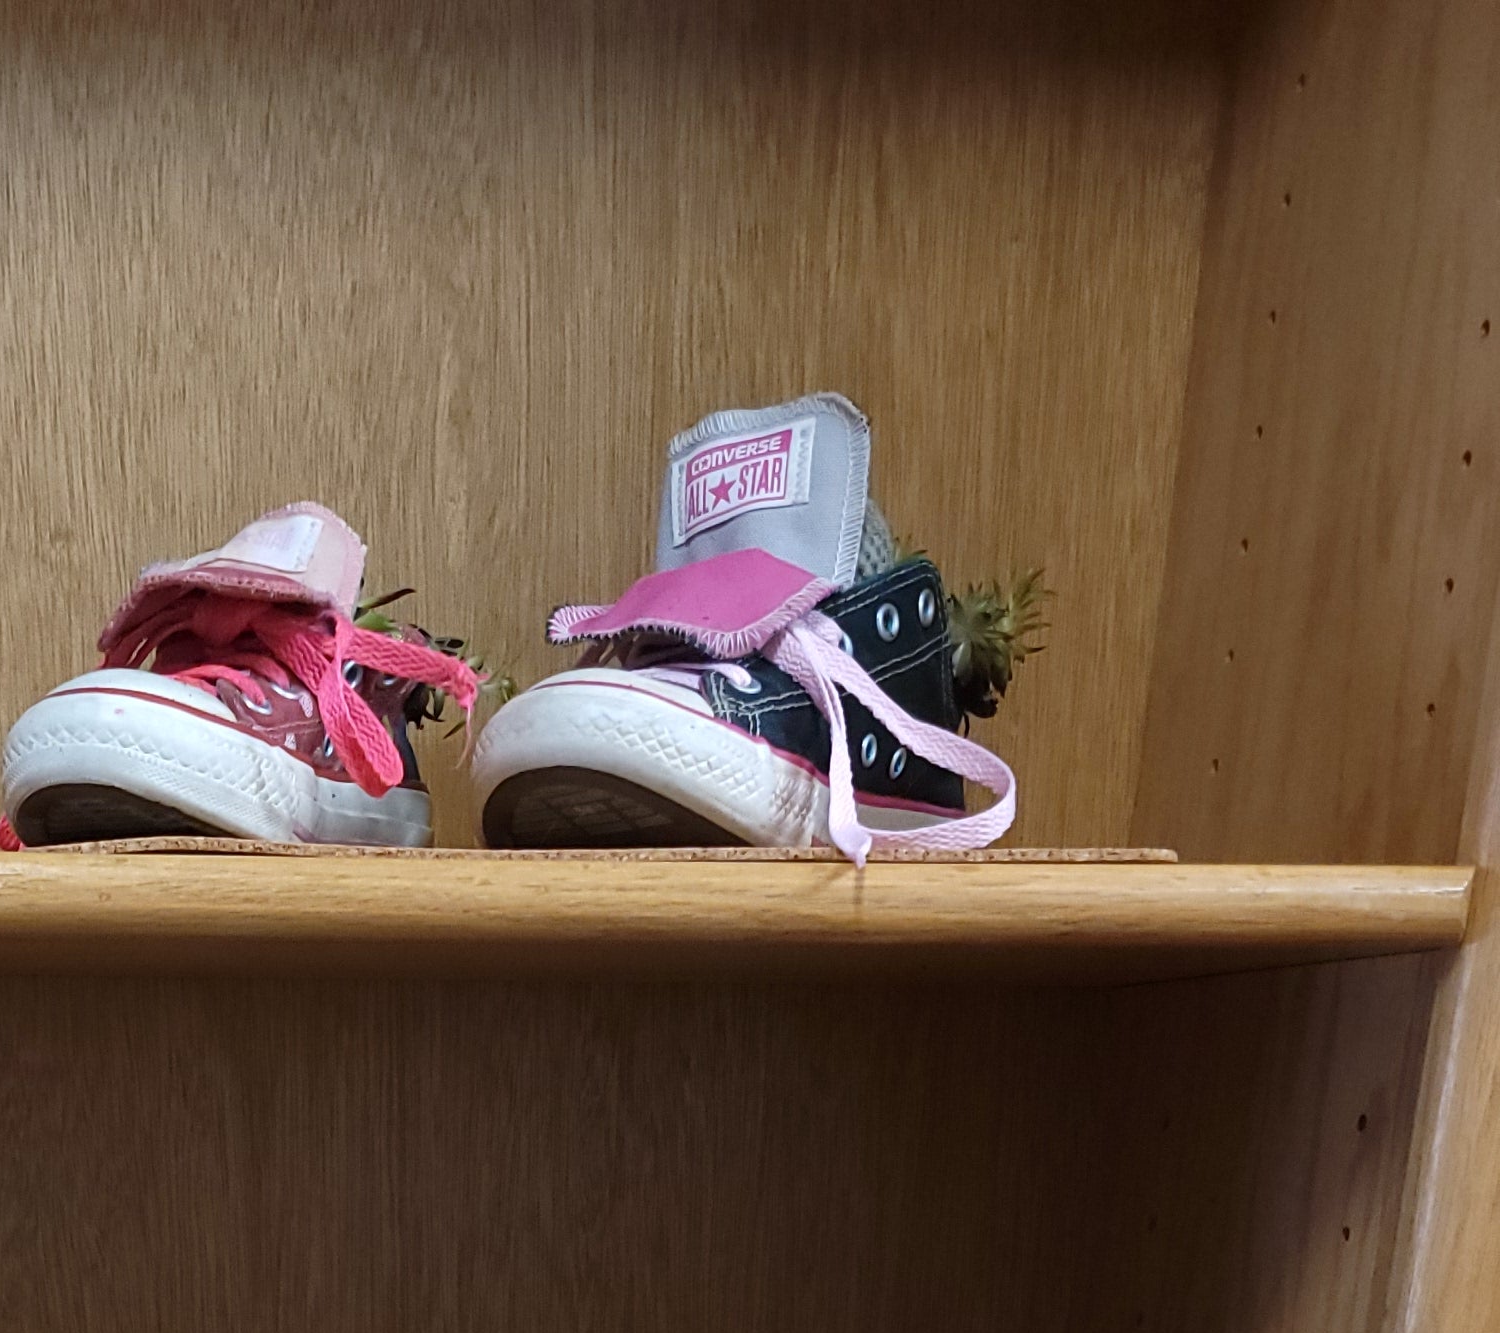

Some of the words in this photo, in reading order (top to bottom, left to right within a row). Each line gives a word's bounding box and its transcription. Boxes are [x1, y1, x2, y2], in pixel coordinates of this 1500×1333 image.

[691, 435, 783, 477] CONVERSE
[687, 478, 710, 525] ALL
[737, 457, 783, 501] STAR
